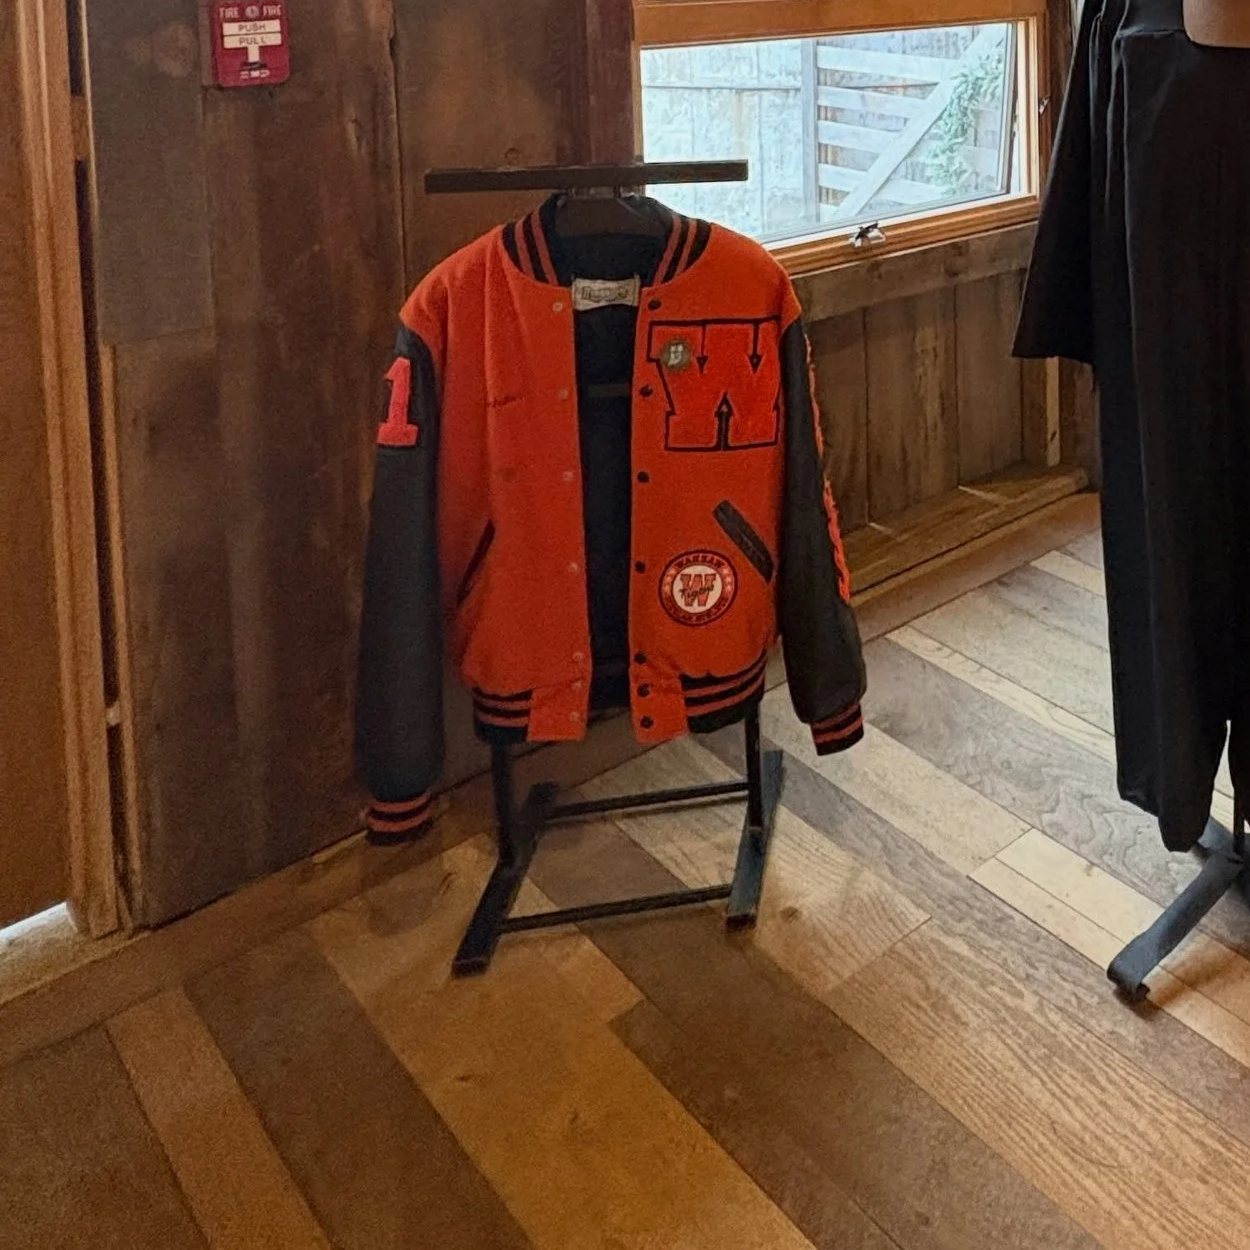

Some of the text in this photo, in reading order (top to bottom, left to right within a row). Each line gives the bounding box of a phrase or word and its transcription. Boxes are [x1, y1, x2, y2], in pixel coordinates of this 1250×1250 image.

[238, 23, 266, 32] PUSH
[239, 37, 266, 45] PULL
[377, 357, 418, 446] 1
[680, 573, 717, 607] W
